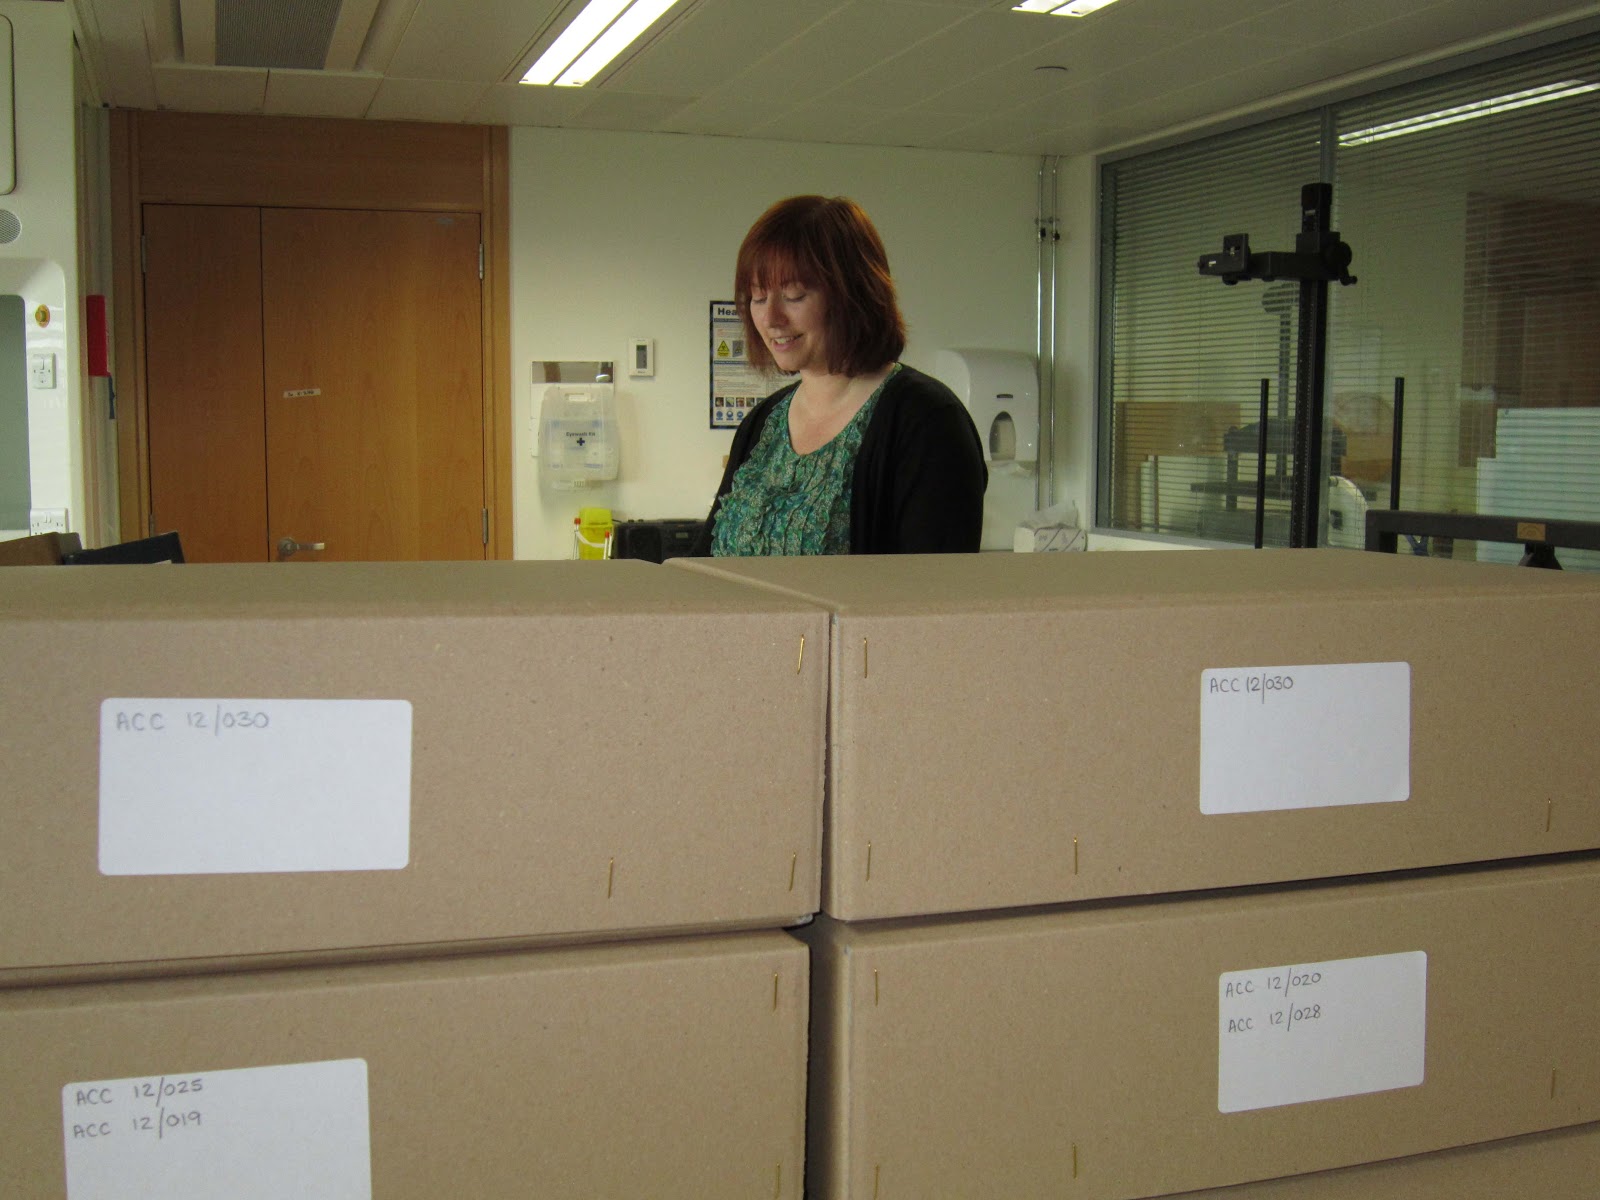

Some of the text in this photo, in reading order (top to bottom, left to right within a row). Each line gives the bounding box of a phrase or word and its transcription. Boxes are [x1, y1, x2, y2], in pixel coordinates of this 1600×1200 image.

[1209, 673, 1294, 705] ACC 12/030
[116, 703, 270, 737] ACC 12/030
[1225, 967, 1322, 998] ACC 12/020
[1228, 1002, 1321, 1033] ACC 12/028
[76, 1076, 204, 1108] ACC 12/025
[73, 1106, 202, 1139] ACC 12/019
